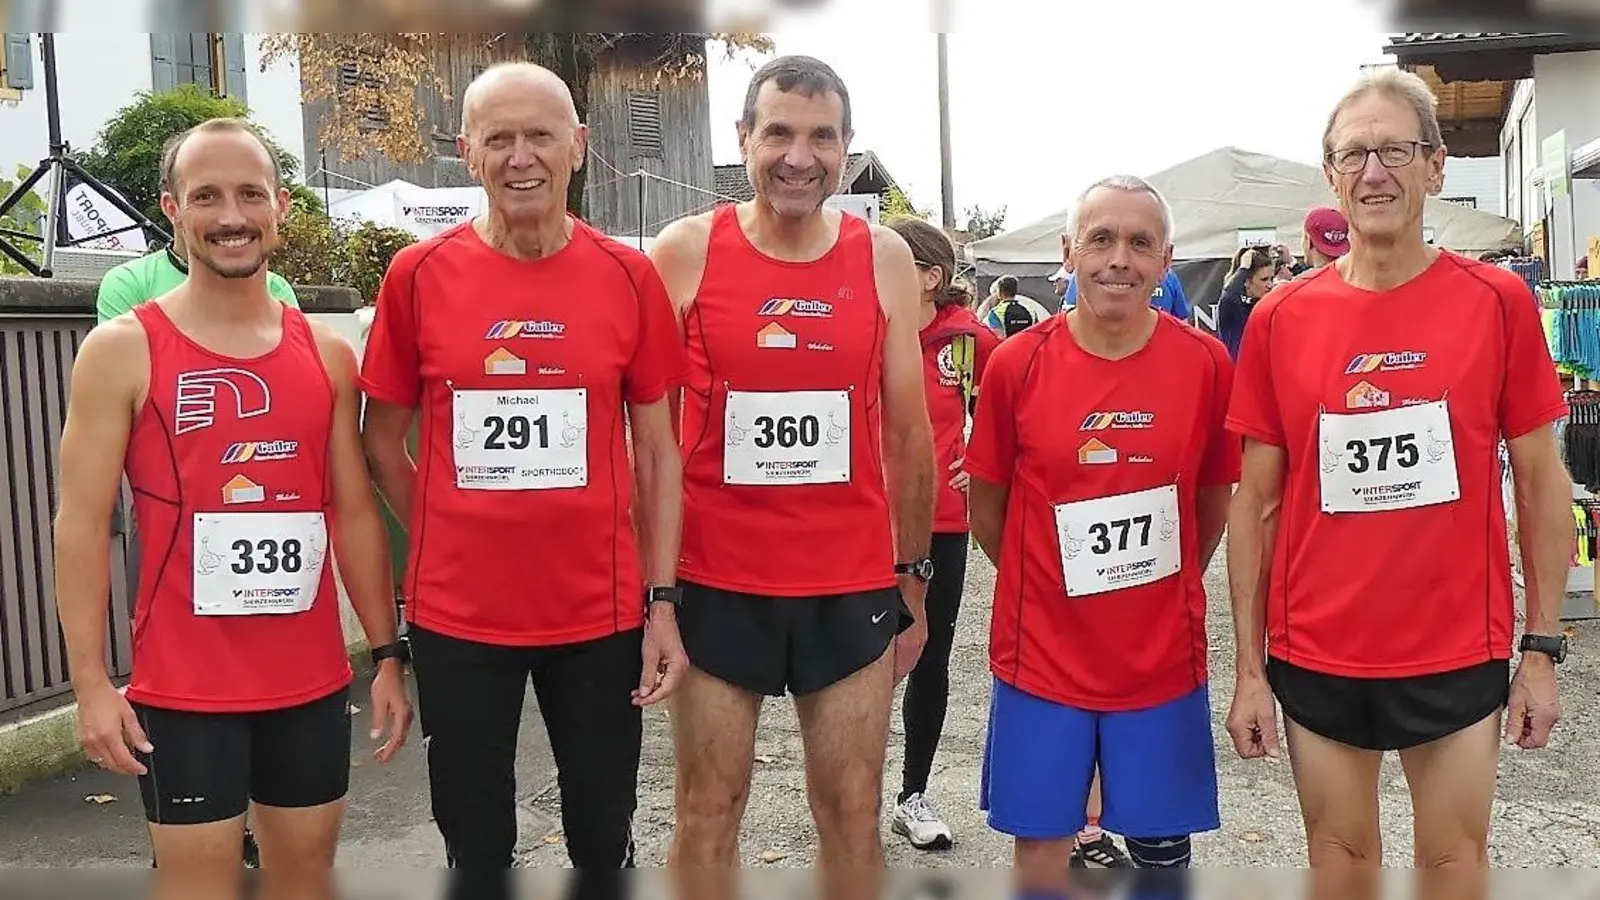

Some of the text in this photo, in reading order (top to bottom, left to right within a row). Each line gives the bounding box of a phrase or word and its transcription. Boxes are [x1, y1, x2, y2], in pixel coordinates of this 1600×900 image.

[412, 206, 469, 217] INTERSPORT
[496, 395, 539, 405] Michael
[483, 414, 549, 450] 291
[754, 415, 819, 449] 360
[1346, 433, 1420, 474] 375
[465, 466, 516, 474] INTERSPORT
[764, 460, 819, 470] INTERSPORT
[1363, 481, 1421, 495] INTERSPORT
[1088, 514, 1153, 555] 377
[230, 539, 303, 575] 338
[1106, 557, 1157, 576] INTERSPORT
[243, 587, 301, 598] INTERSPORT
